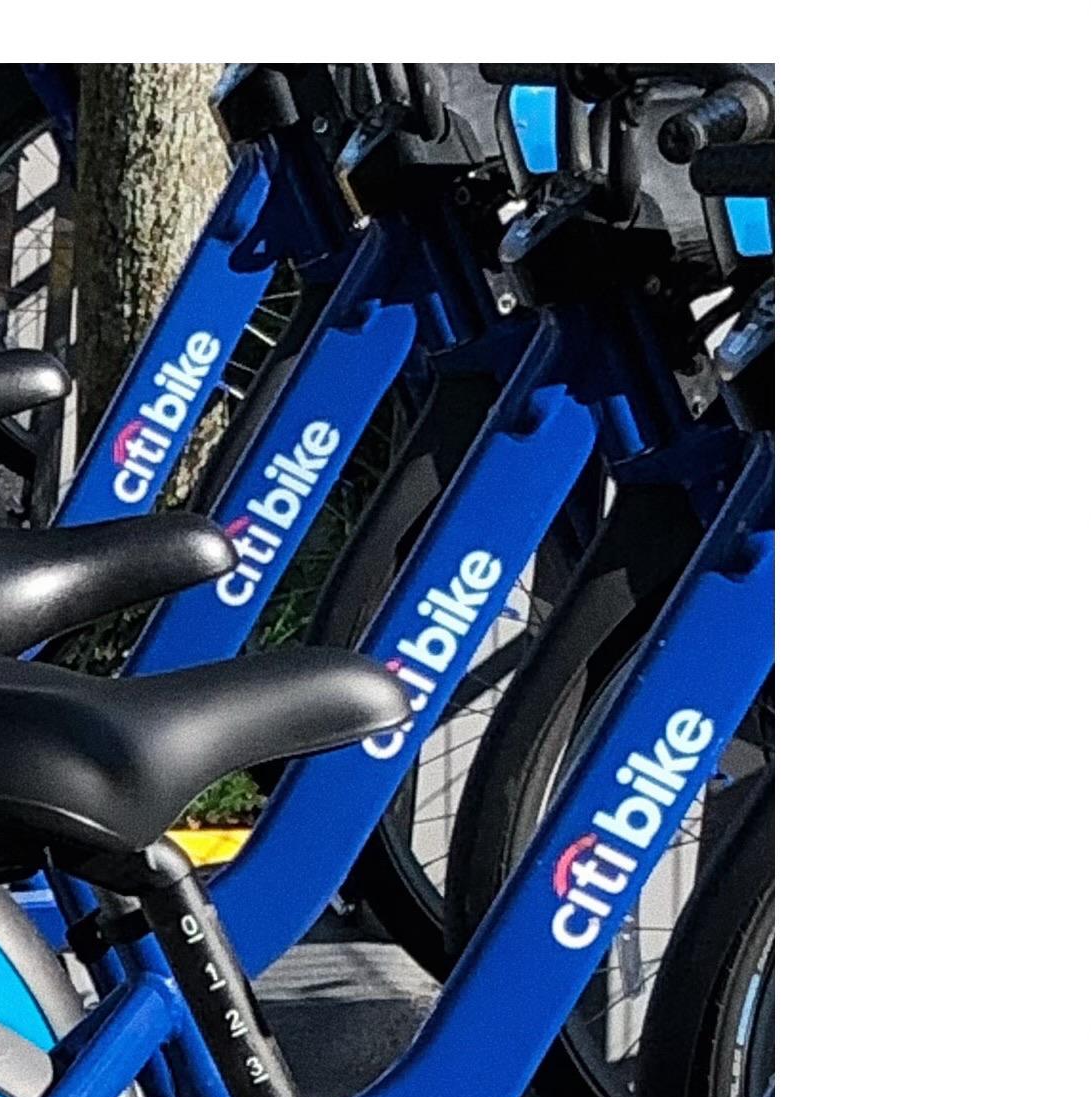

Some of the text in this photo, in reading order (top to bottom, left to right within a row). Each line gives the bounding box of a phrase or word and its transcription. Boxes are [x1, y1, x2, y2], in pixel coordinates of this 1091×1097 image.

[112, 331, 221, 503] citi bike
[215, 421, 340, 607] citi bike
[397, 550, 502, 672] bike
[551, 708, 714, 950] citi bike
